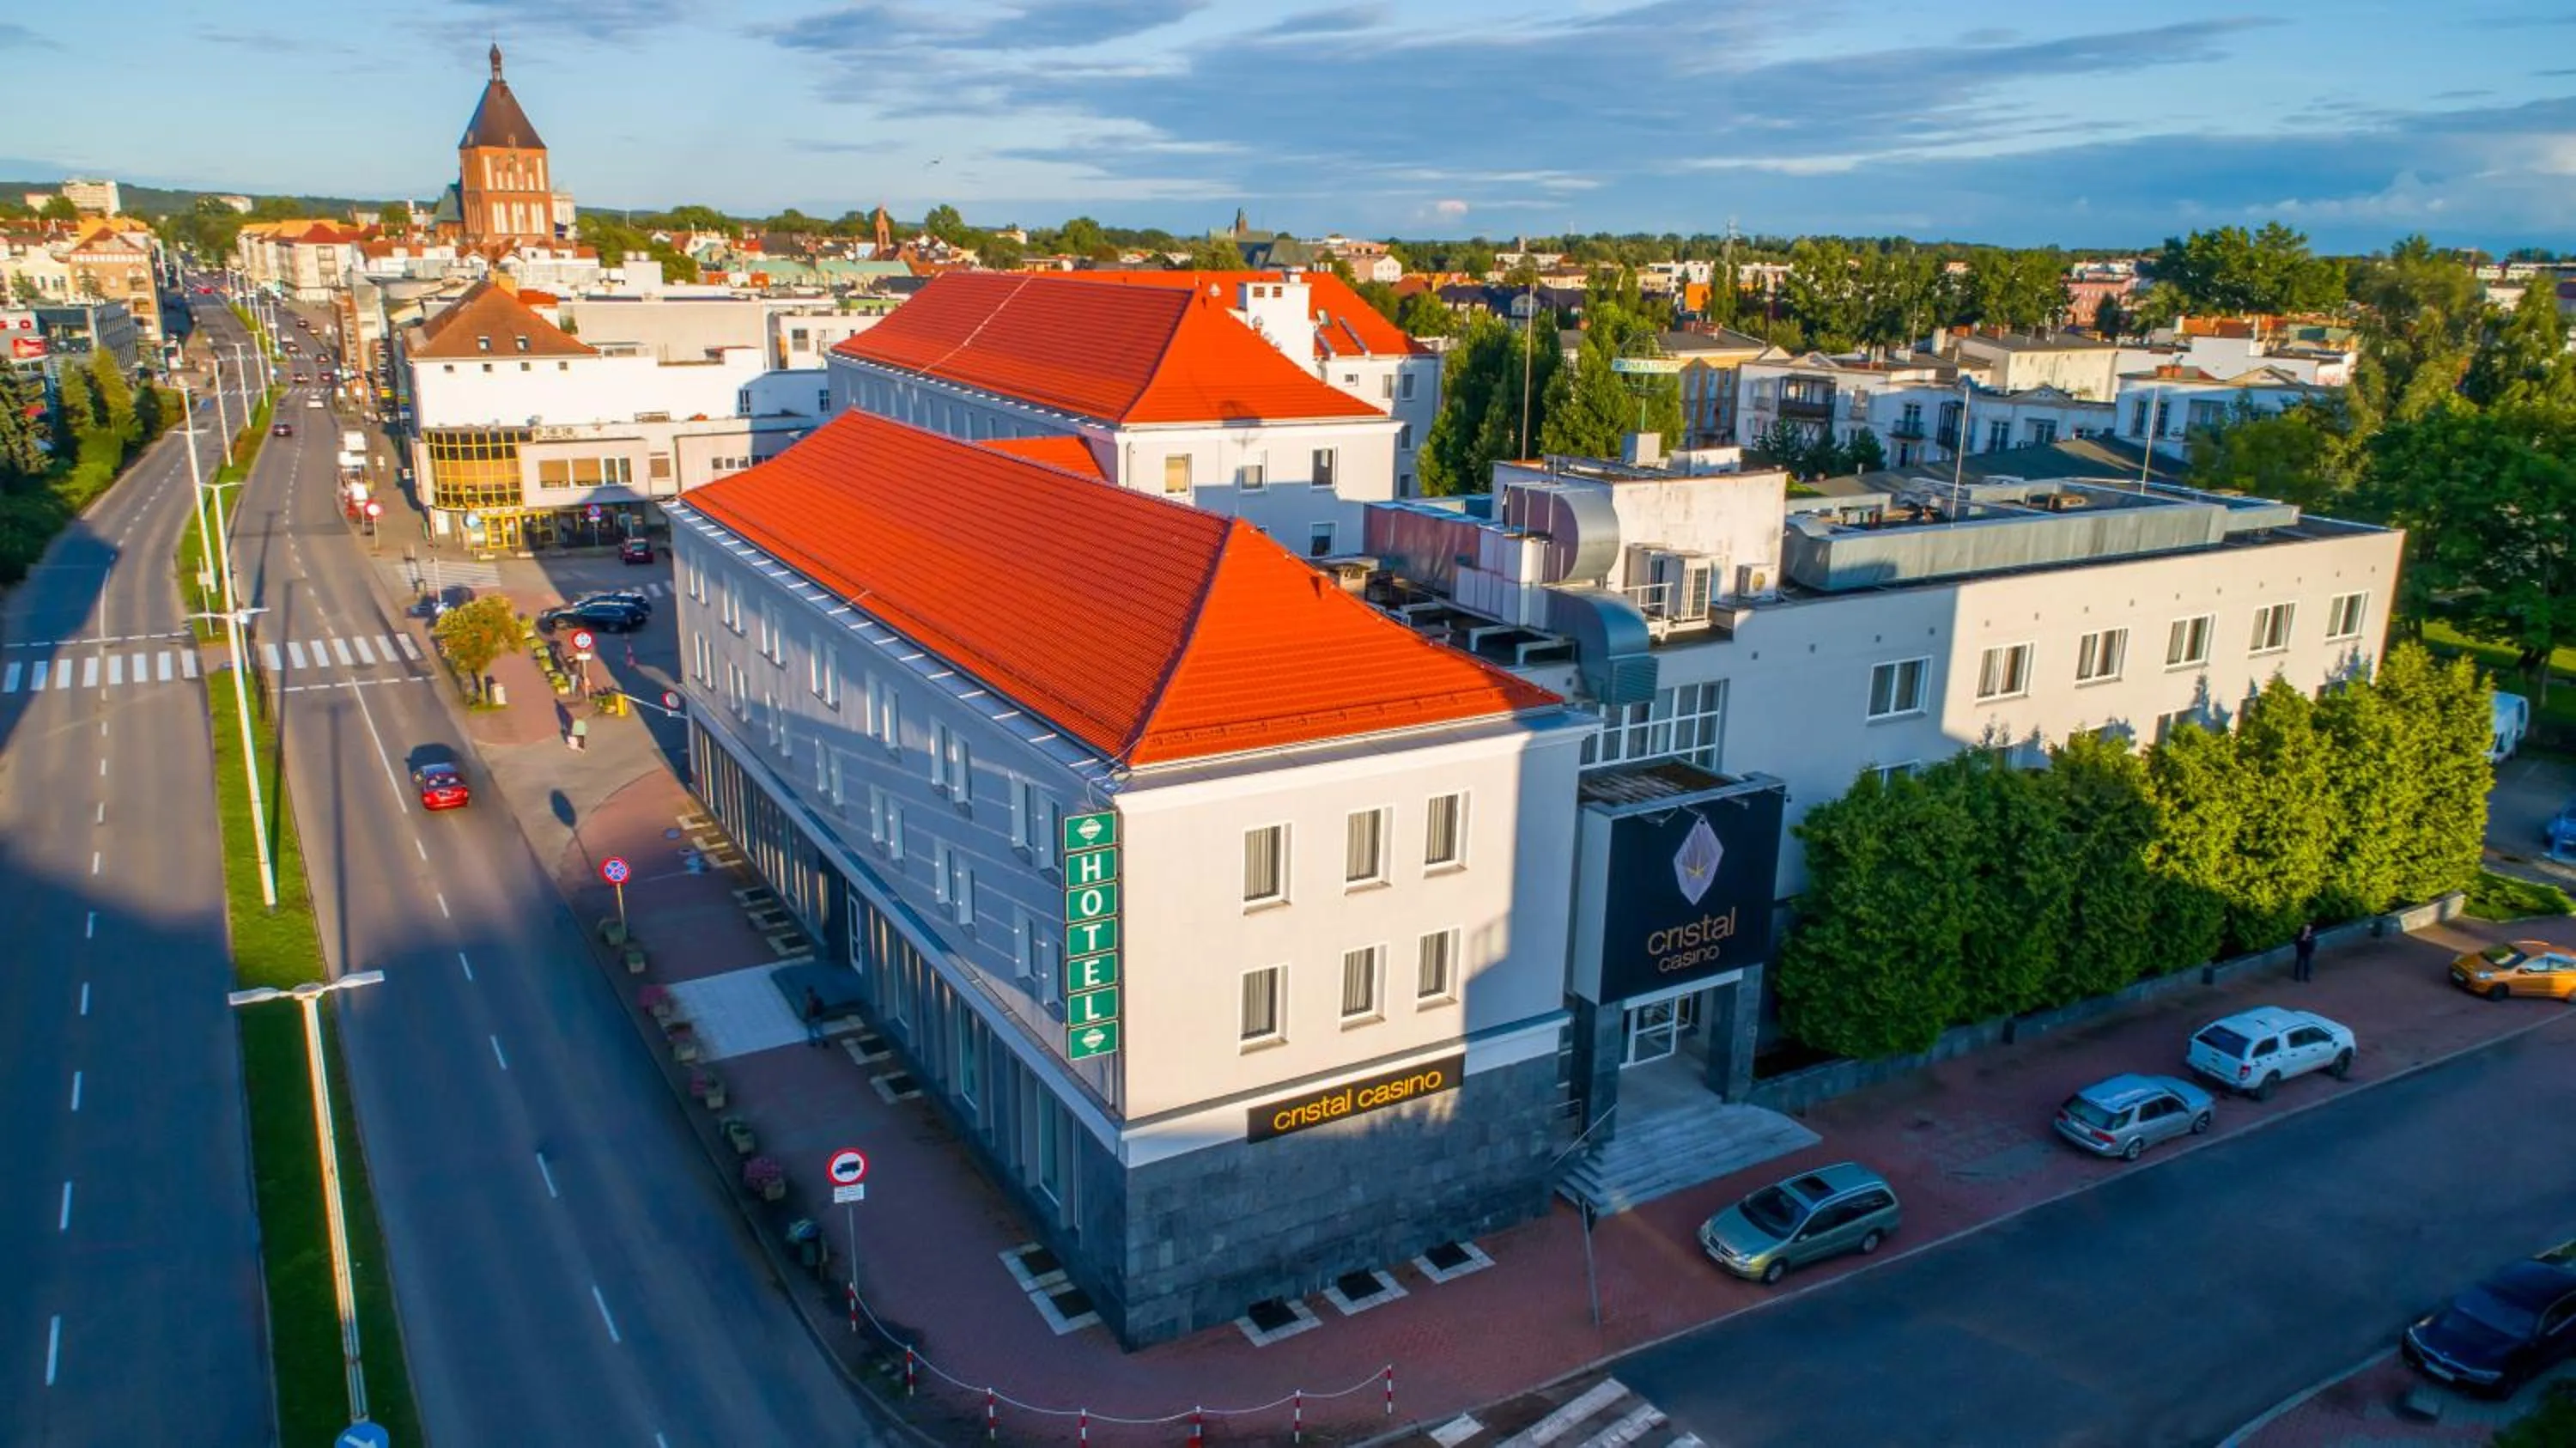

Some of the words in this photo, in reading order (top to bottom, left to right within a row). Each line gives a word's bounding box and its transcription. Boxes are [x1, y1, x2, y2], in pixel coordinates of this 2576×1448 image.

[1079, 854, 1103, 1021] HOTEL
[1648, 906, 1736, 956] cristal
[1658, 945, 1721, 973] casino
[1273, 1090, 1352, 1131] cristal
[1358, 1071, 1443, 1109] casino
